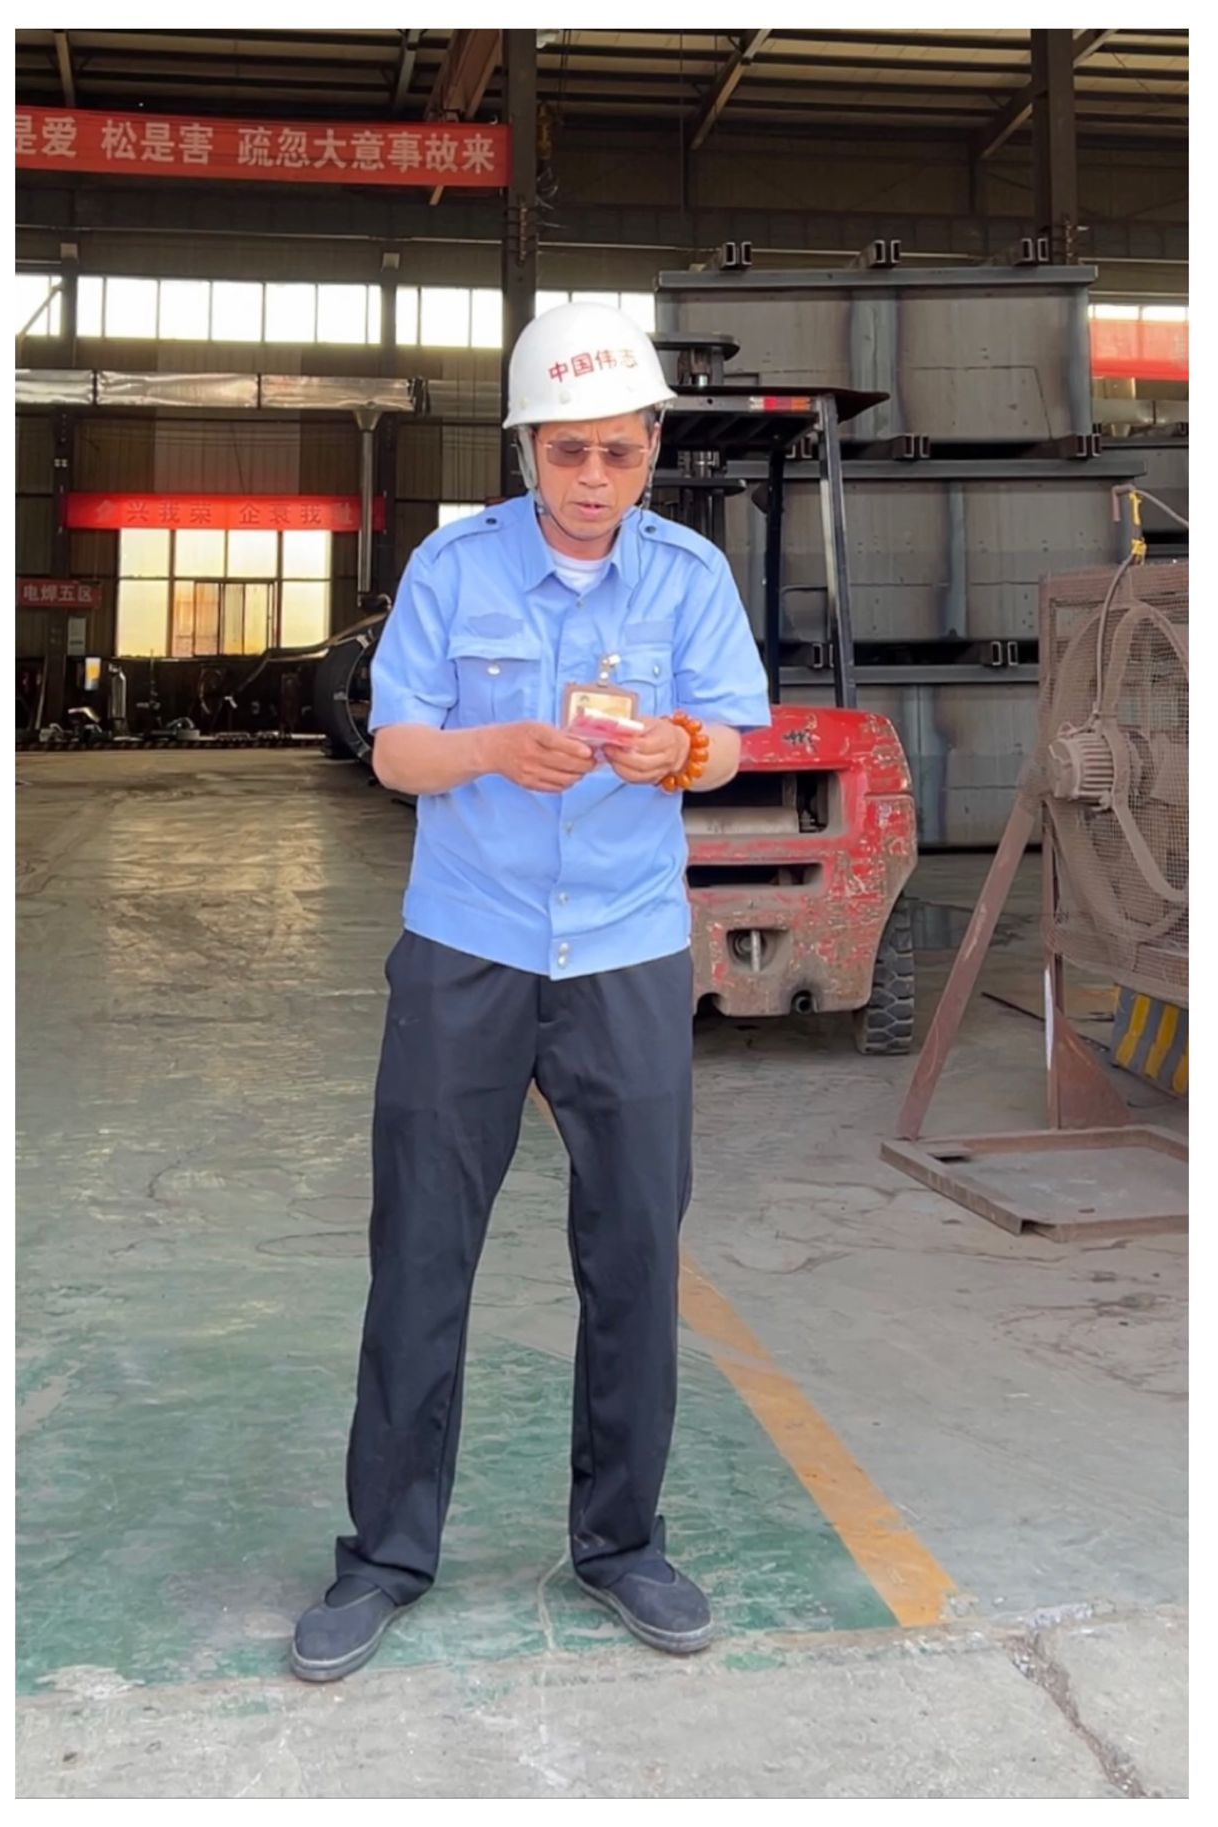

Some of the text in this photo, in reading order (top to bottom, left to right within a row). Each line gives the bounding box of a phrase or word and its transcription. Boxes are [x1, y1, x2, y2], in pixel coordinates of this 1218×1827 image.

[101, 119, 213, 165] 松是害
[237, 126, 495, 175] 疏忽大意事故来
[548, 348, 638, 383] 中国伟志
[23, 584, 93, 602] 电焊五区
